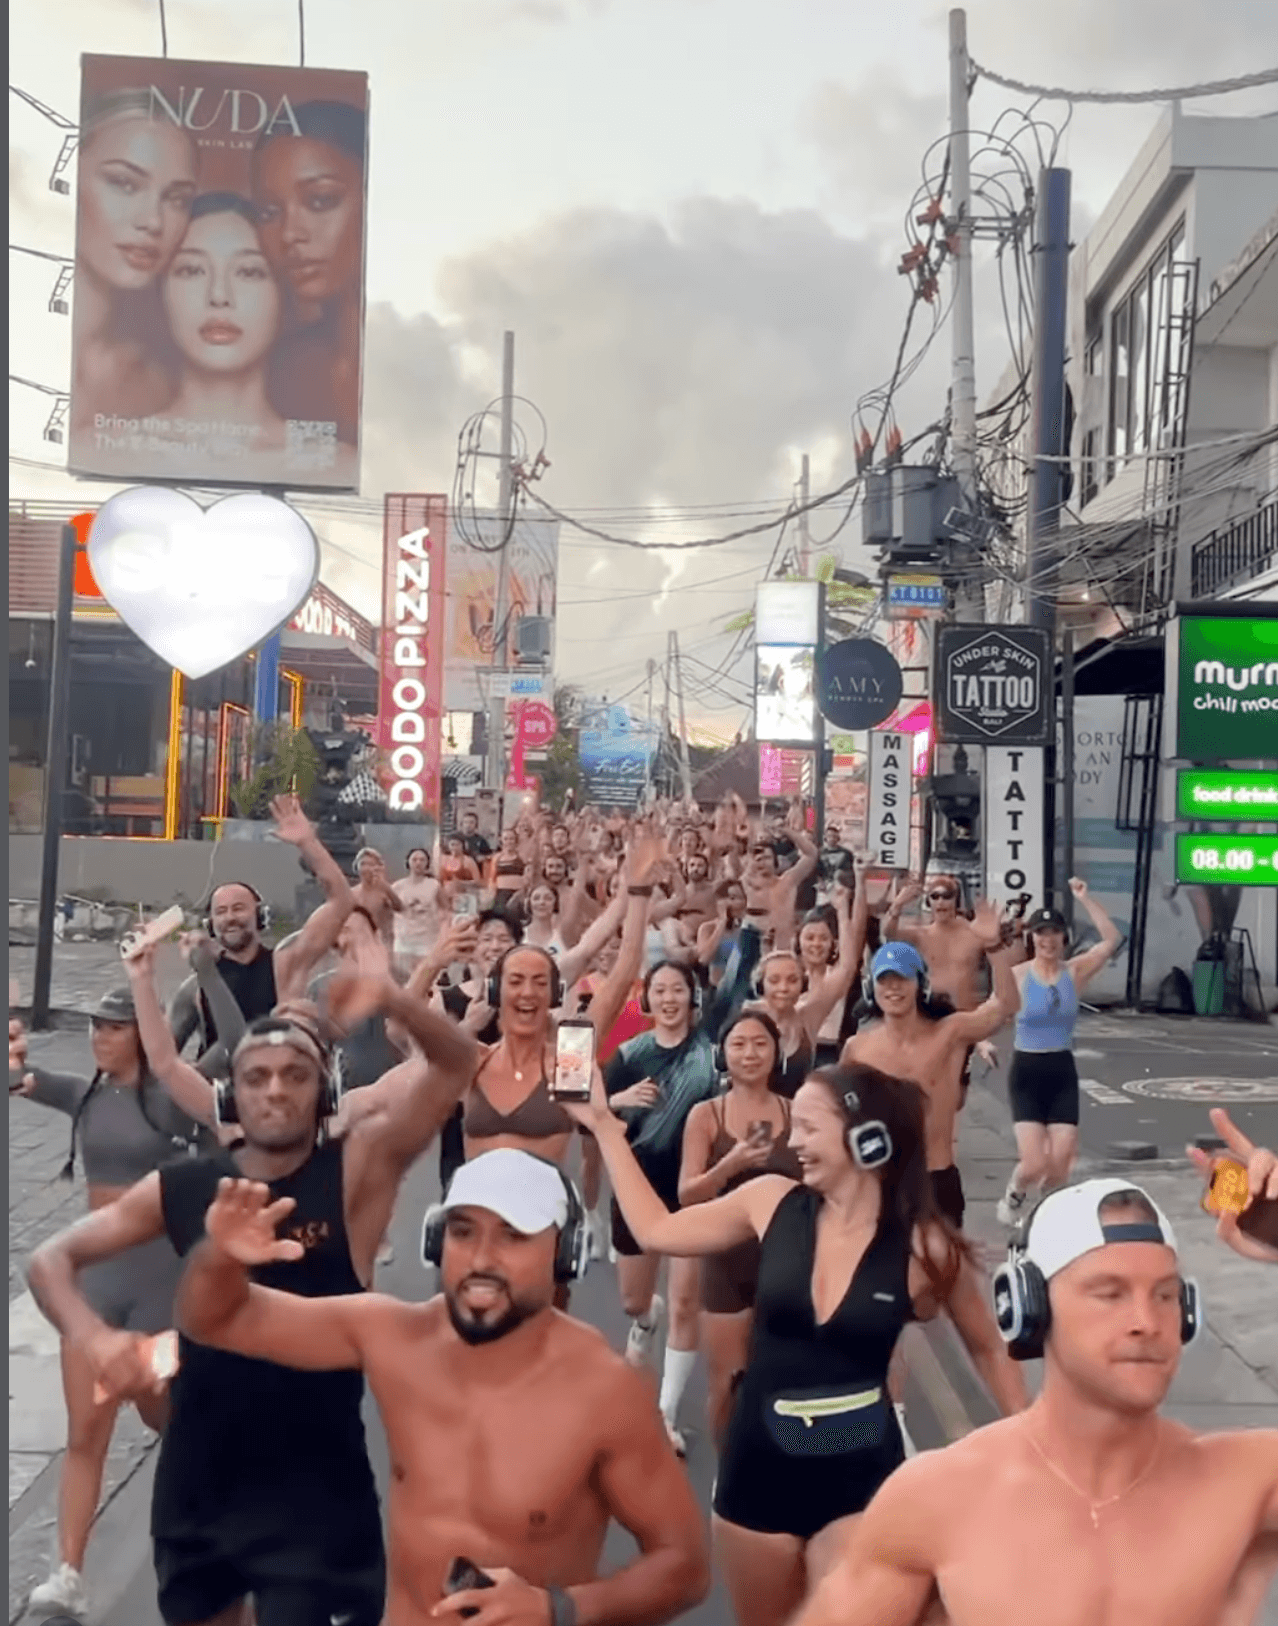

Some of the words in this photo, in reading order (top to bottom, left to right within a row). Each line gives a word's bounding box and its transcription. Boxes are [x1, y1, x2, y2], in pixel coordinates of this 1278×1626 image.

[150, 84, 302, 136] NUDA
[94, 413, 139, 431] Bring
[143, 416, 171, 431] the
[394, 526, 430, 667] PIZZA
[952, 646, 1000, 668] UNDER
[1002, 647, 1036, 670] SKIN
[828, 675, 885, 694] AMY
[952, 674, 1034, 708] TATTOO
[1193, 692, 1237, 713] chill
[389, 677, 426, 811] DODO
[880, 734, 902, 865] MASSAGE
[1194, 787, 1232, 802] food
[1192, 849, 1254, 869] 08.00
